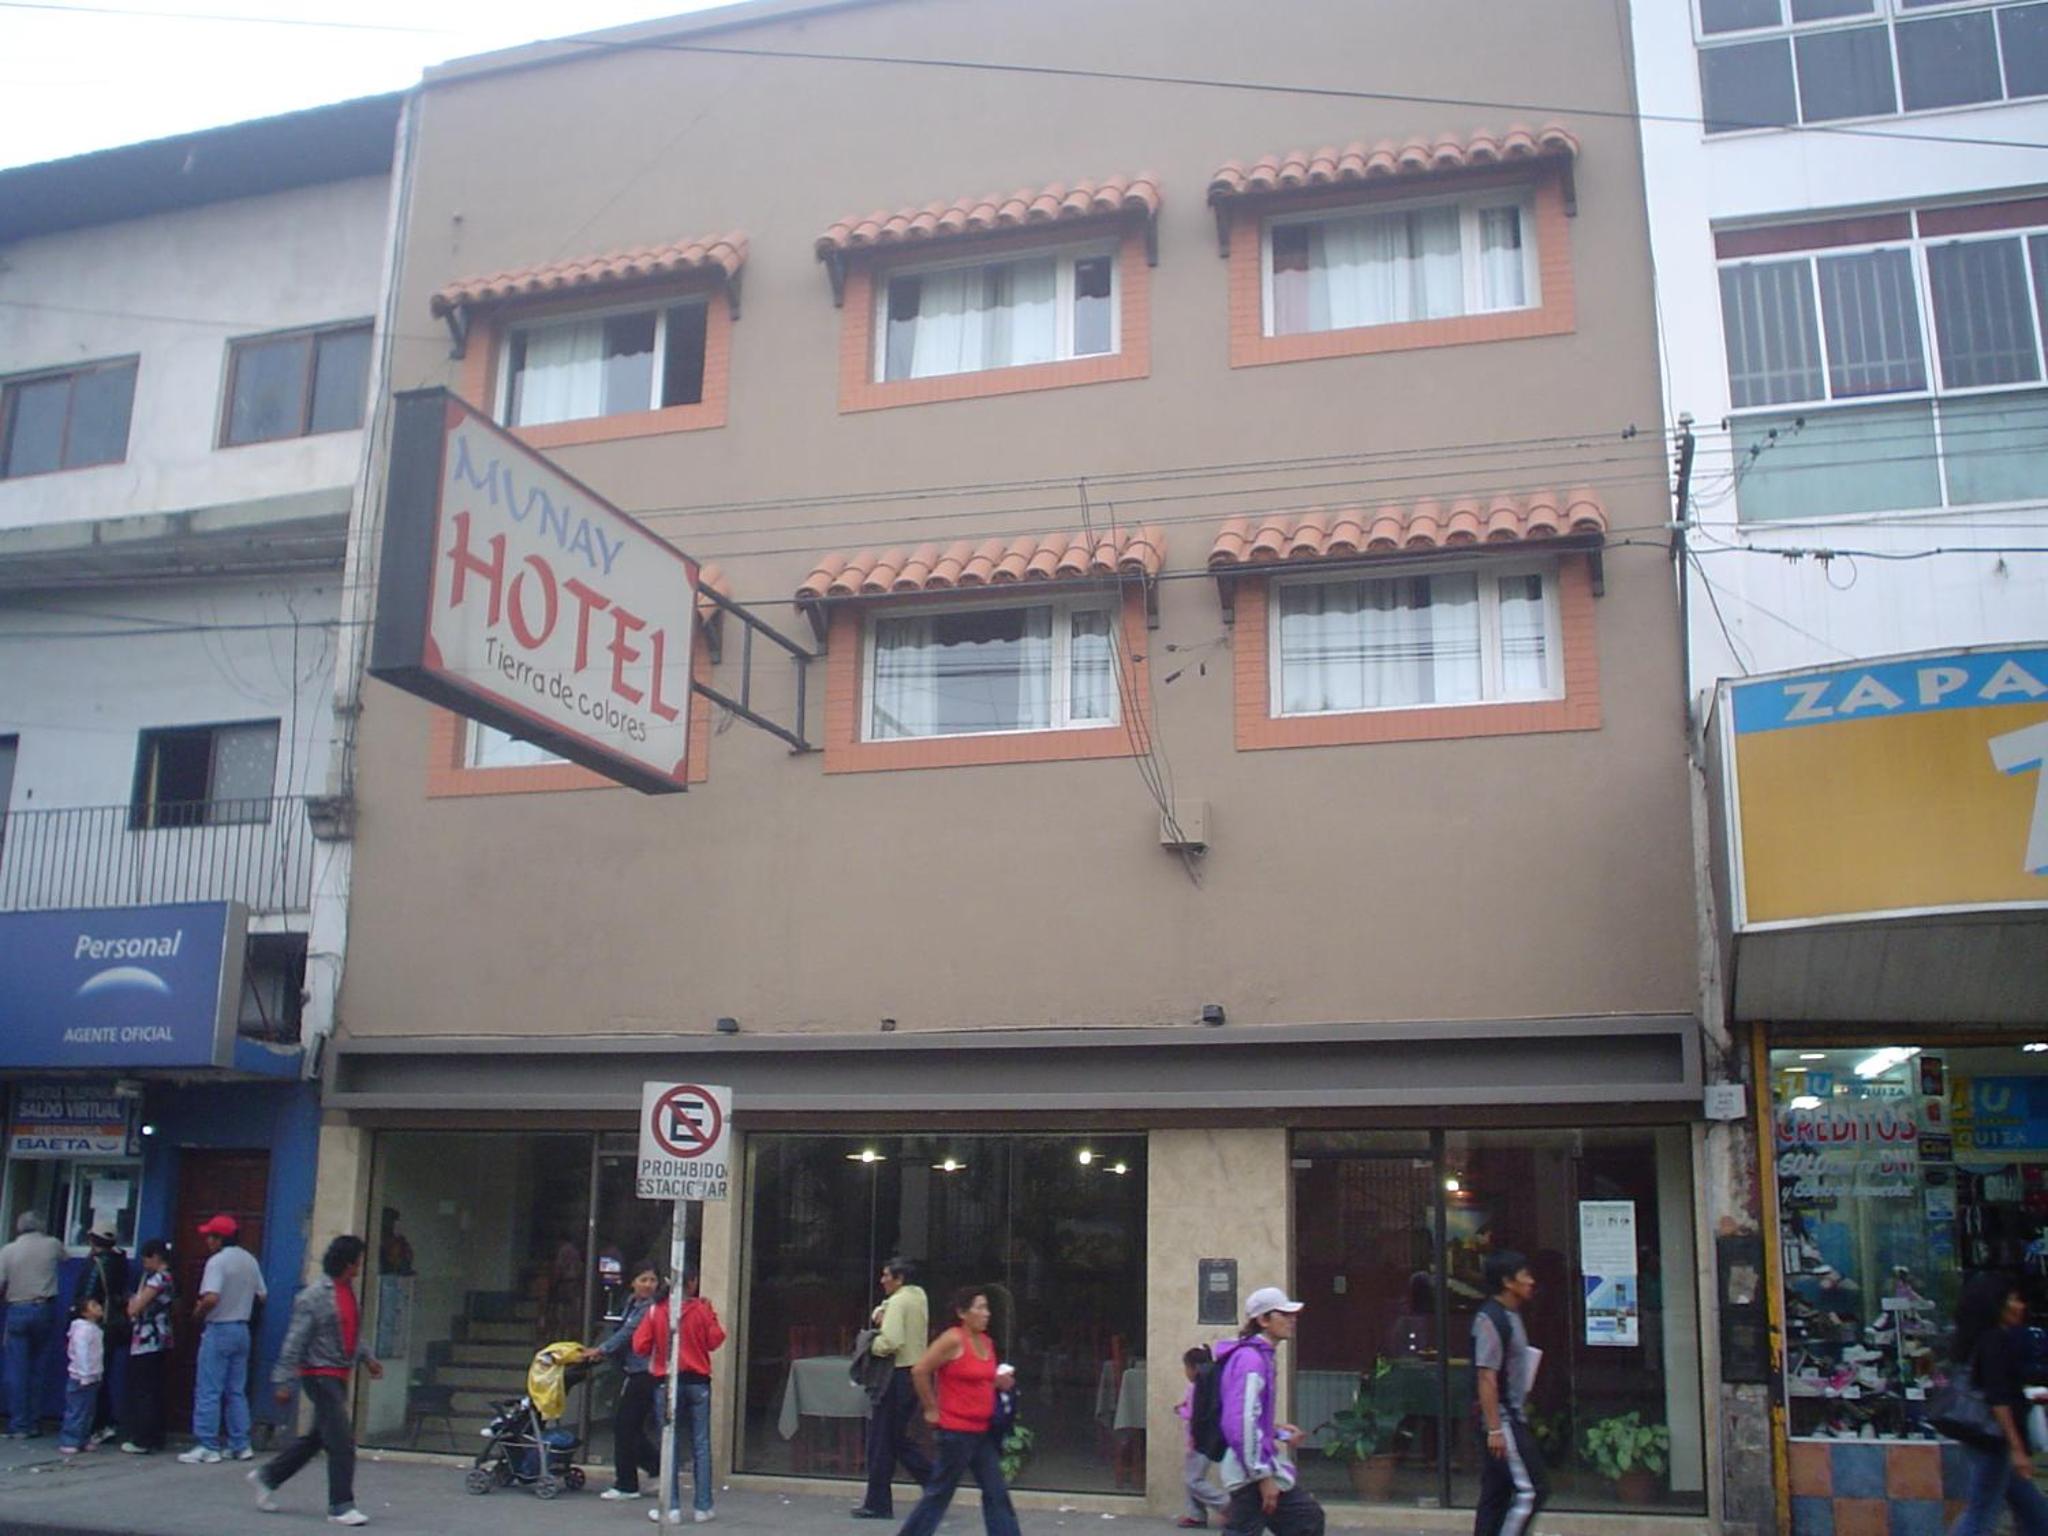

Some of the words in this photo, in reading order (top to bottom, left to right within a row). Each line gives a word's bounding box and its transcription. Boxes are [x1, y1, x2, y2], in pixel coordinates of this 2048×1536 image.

[454, 436, 626, 576] MUNAY
[447, 510, 680, 723] HOTEL
[486, 636, 545, 694] Tierra
[549, 673, 573, 710] de
[1783, 659, 2048, 722] ZAPA
[74, 929, 183, 960] Personal
[64, 1027, 118, 1043] AGENTE
[121, 1026, 174, 1042] OFICIAL
[19, 1101, 64, 1118] SALDO
[66, 1101, 122, 1118] VIRTUAL
[669, 1101, 704, 1142] E
[641, 1160, 726, 1179] PROHIBIDO
